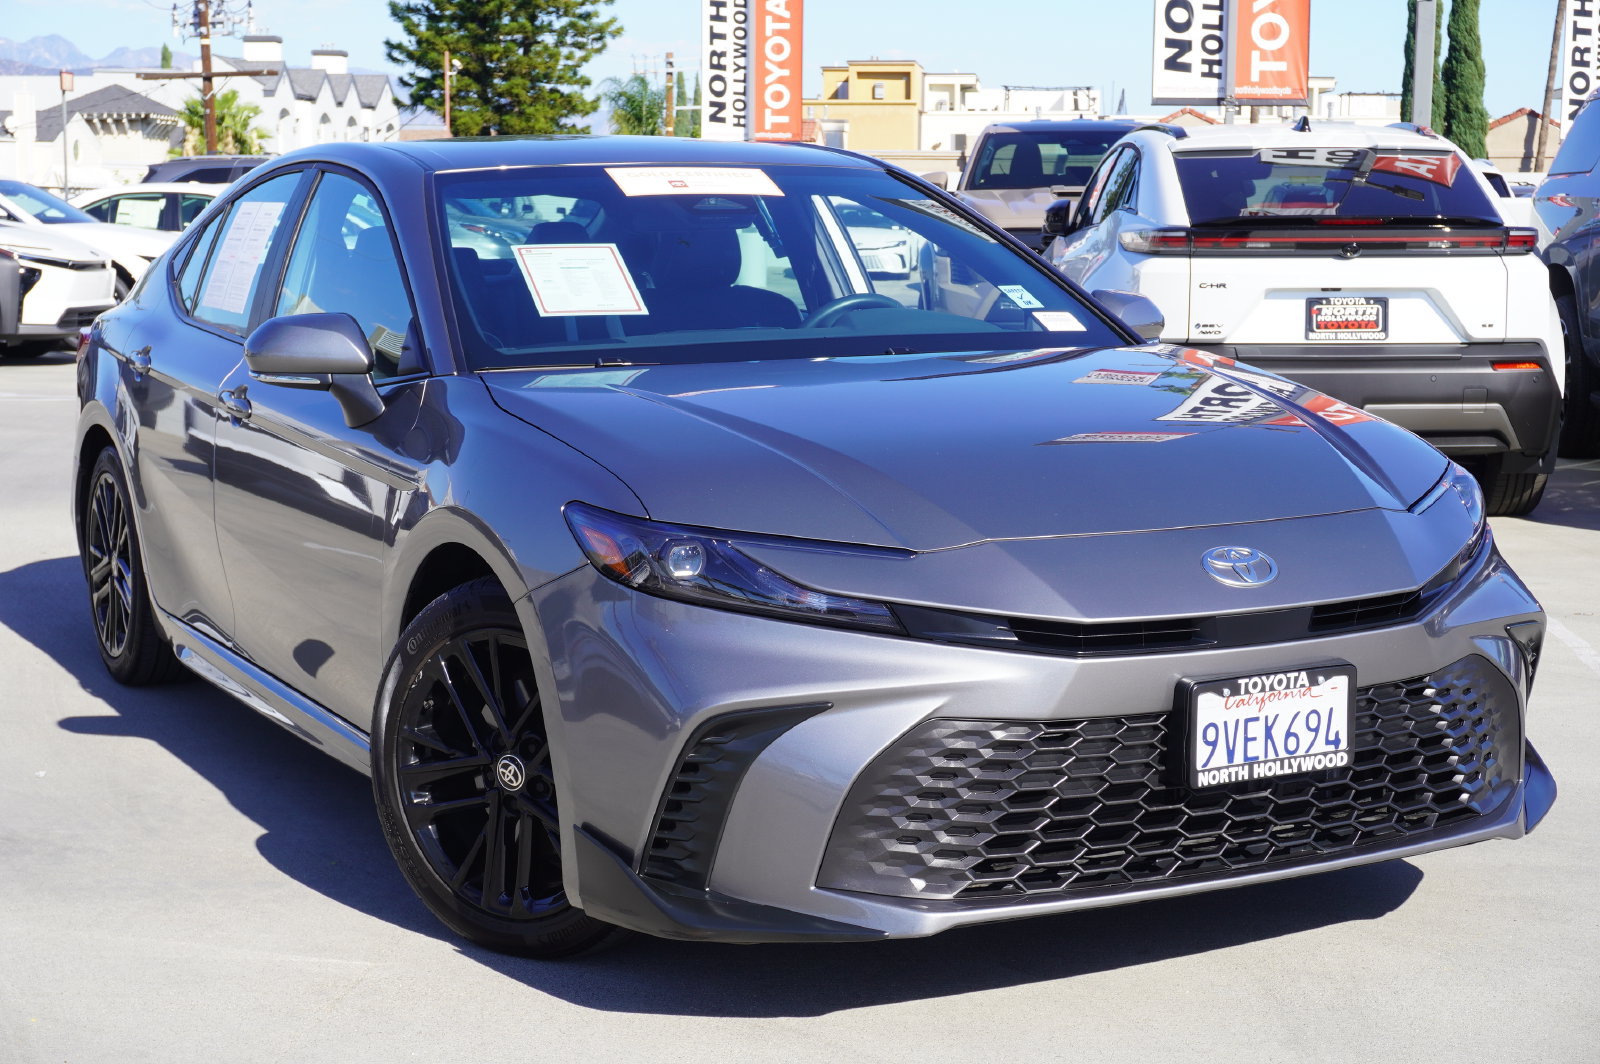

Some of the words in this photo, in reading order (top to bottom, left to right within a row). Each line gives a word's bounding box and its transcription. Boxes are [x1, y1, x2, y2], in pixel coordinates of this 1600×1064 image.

[709, 0, 727, 123] NORTH
[732, 0, 748, 127] HOLLYWOOD
[764, 0, 791, 130] TOYOTA
[1568, 0, 1593, 120] NORTH
[1317, 321, 1378, 329] TOYOTA
[1320, 307, 1378, 316] NORTH
[1309, 332, 1336, 340] NORTH
[1338, 332, 1386, 340] HOLLYWOOD
[1224, 686, 1322, 712] California
[1238, 671, 1310, 695] TOYOTA
[1201, 707, 1341, 768] 9VEK694
[1198, 765, 1249, 787] NORTH
[1253, 752, 1348, 779] HOLLYWOOD
